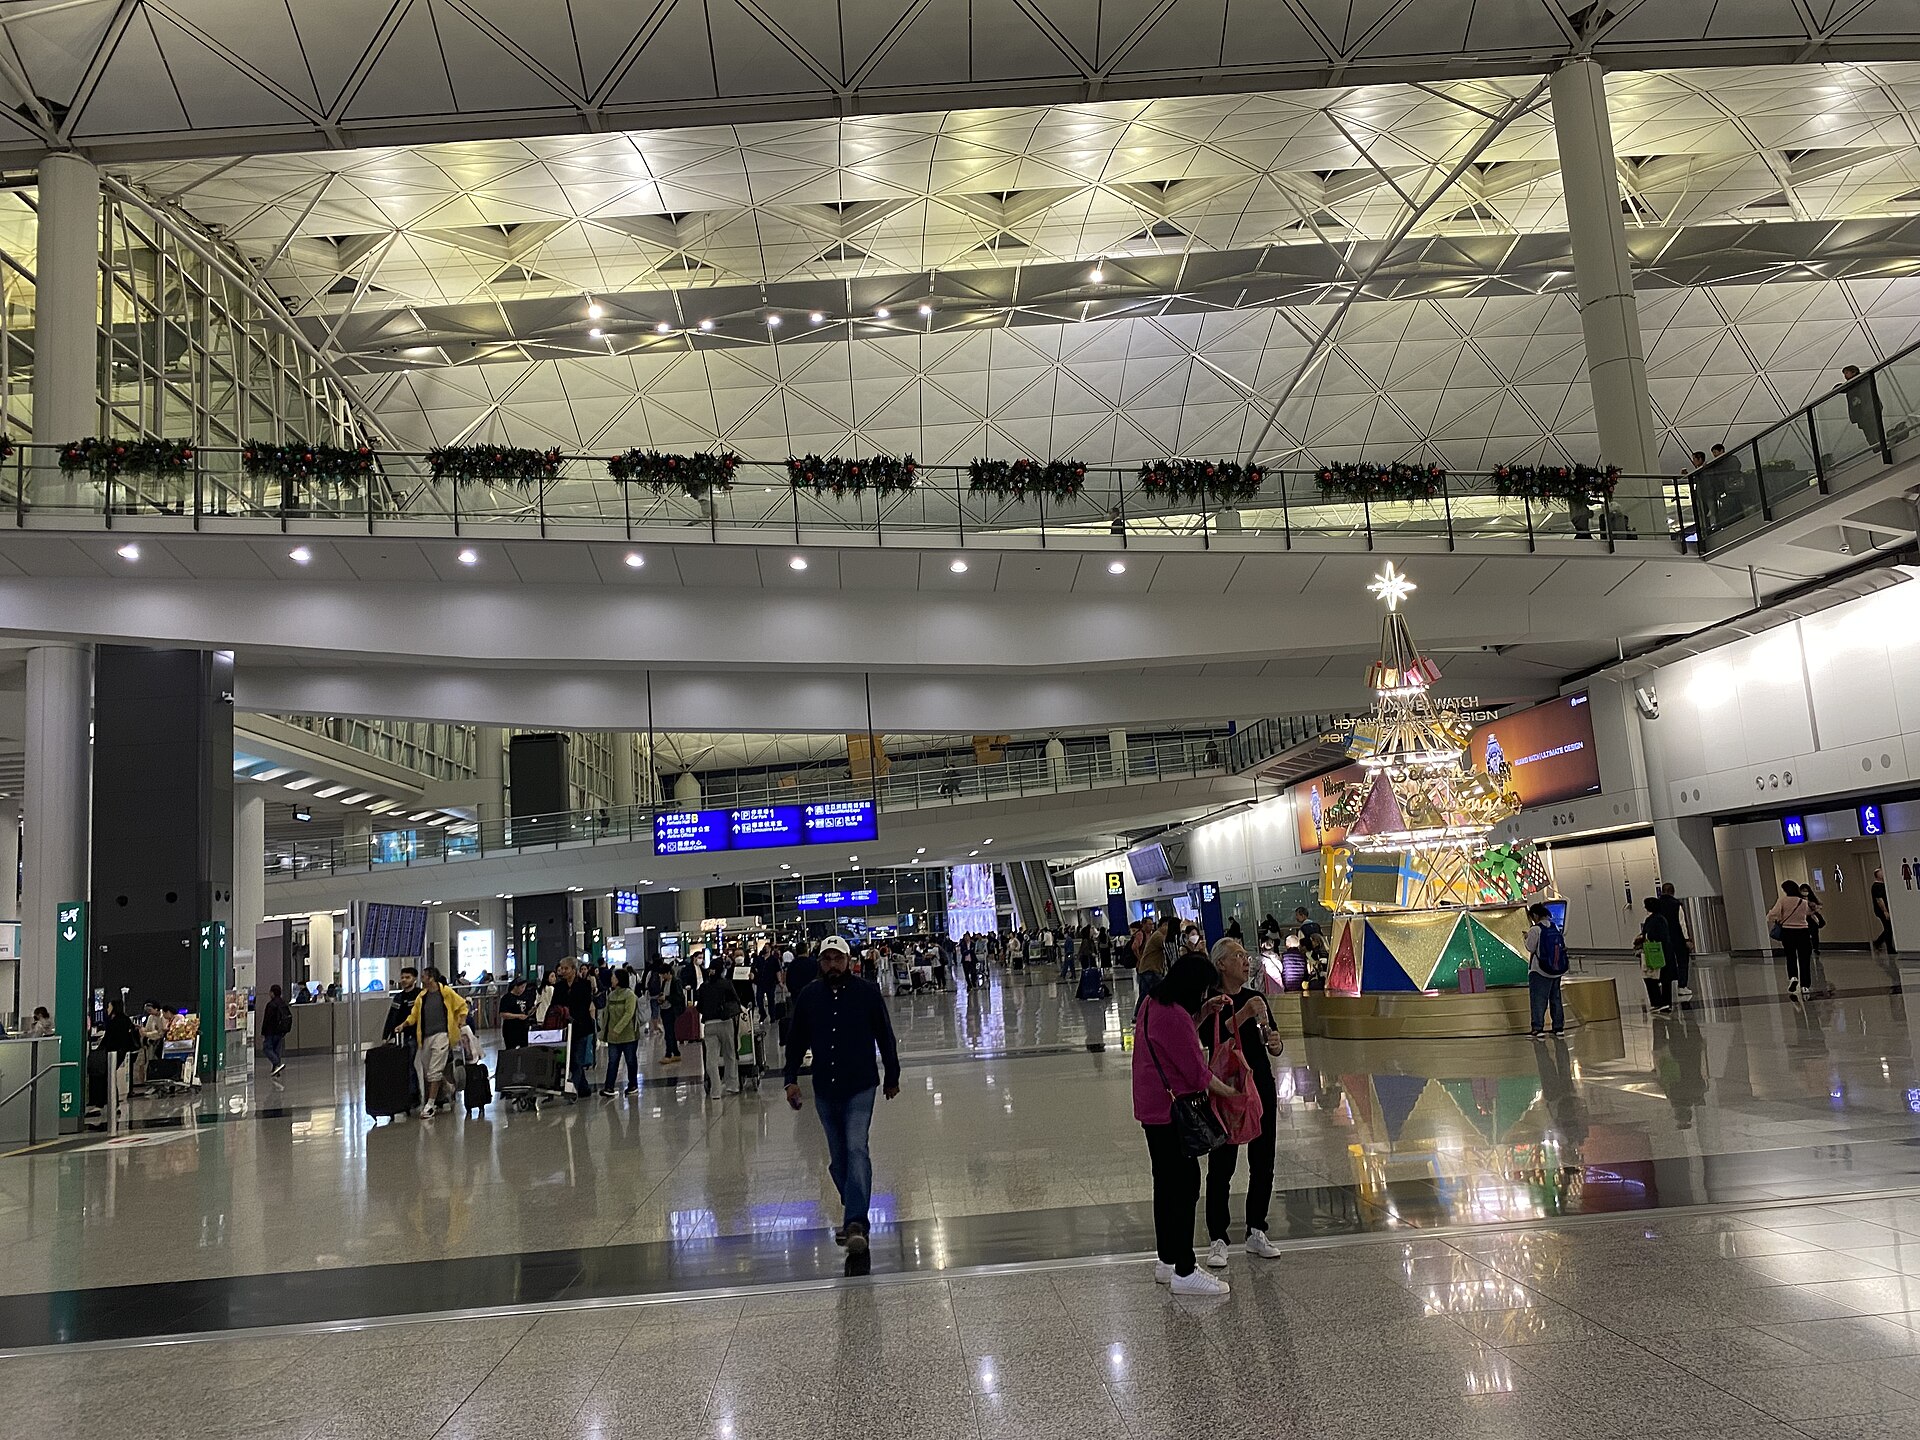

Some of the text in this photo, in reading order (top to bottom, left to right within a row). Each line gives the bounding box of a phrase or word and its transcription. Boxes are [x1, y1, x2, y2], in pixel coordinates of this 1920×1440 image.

[1434, 696, 1479, 710] WATCH
[691, 813, 698, 824] B
[1108, 873, 1121, 889] B
